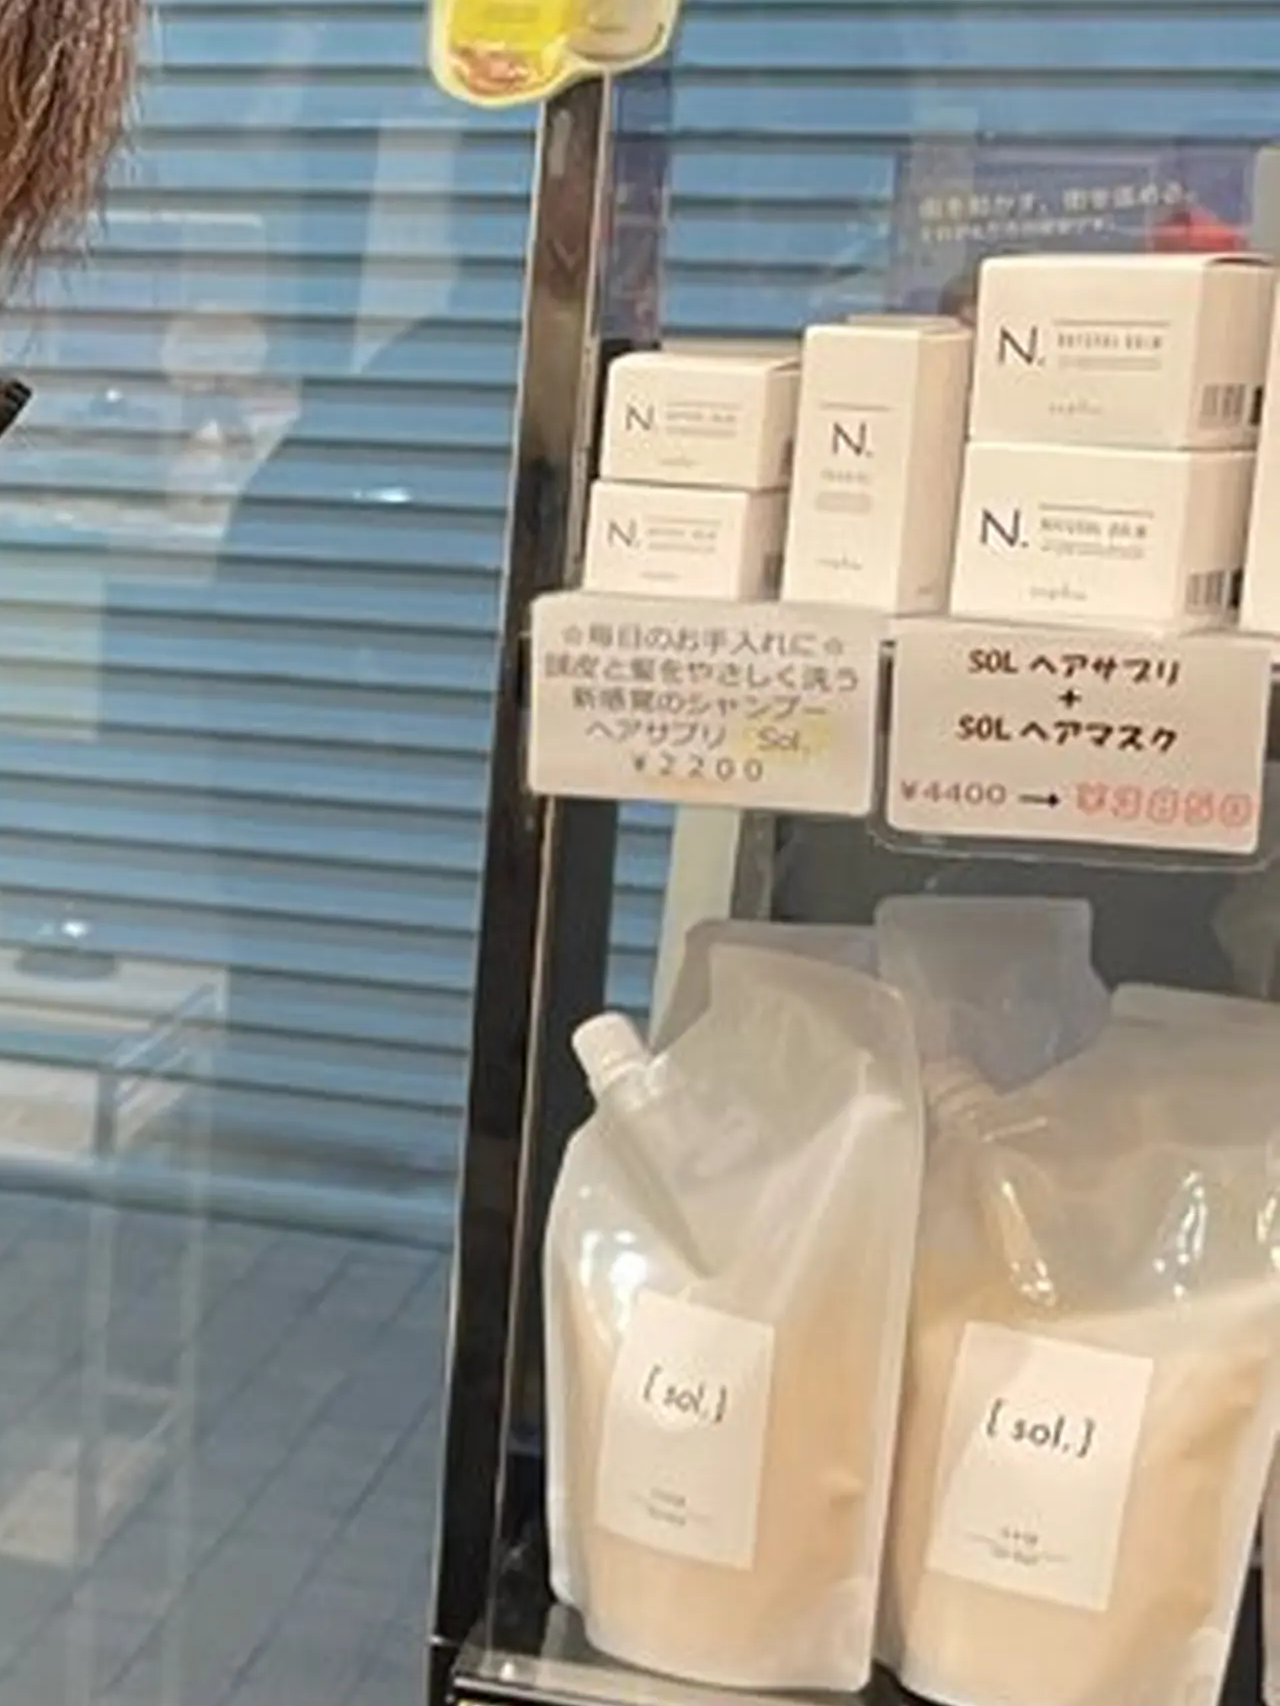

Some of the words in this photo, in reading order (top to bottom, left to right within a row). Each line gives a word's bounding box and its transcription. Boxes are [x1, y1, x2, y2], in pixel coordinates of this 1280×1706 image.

[967, 648, 1019, 675] SOL
[956, 713, 1011, 742] SOL
[1019, 720, 1178, 753] ヘアマスク
